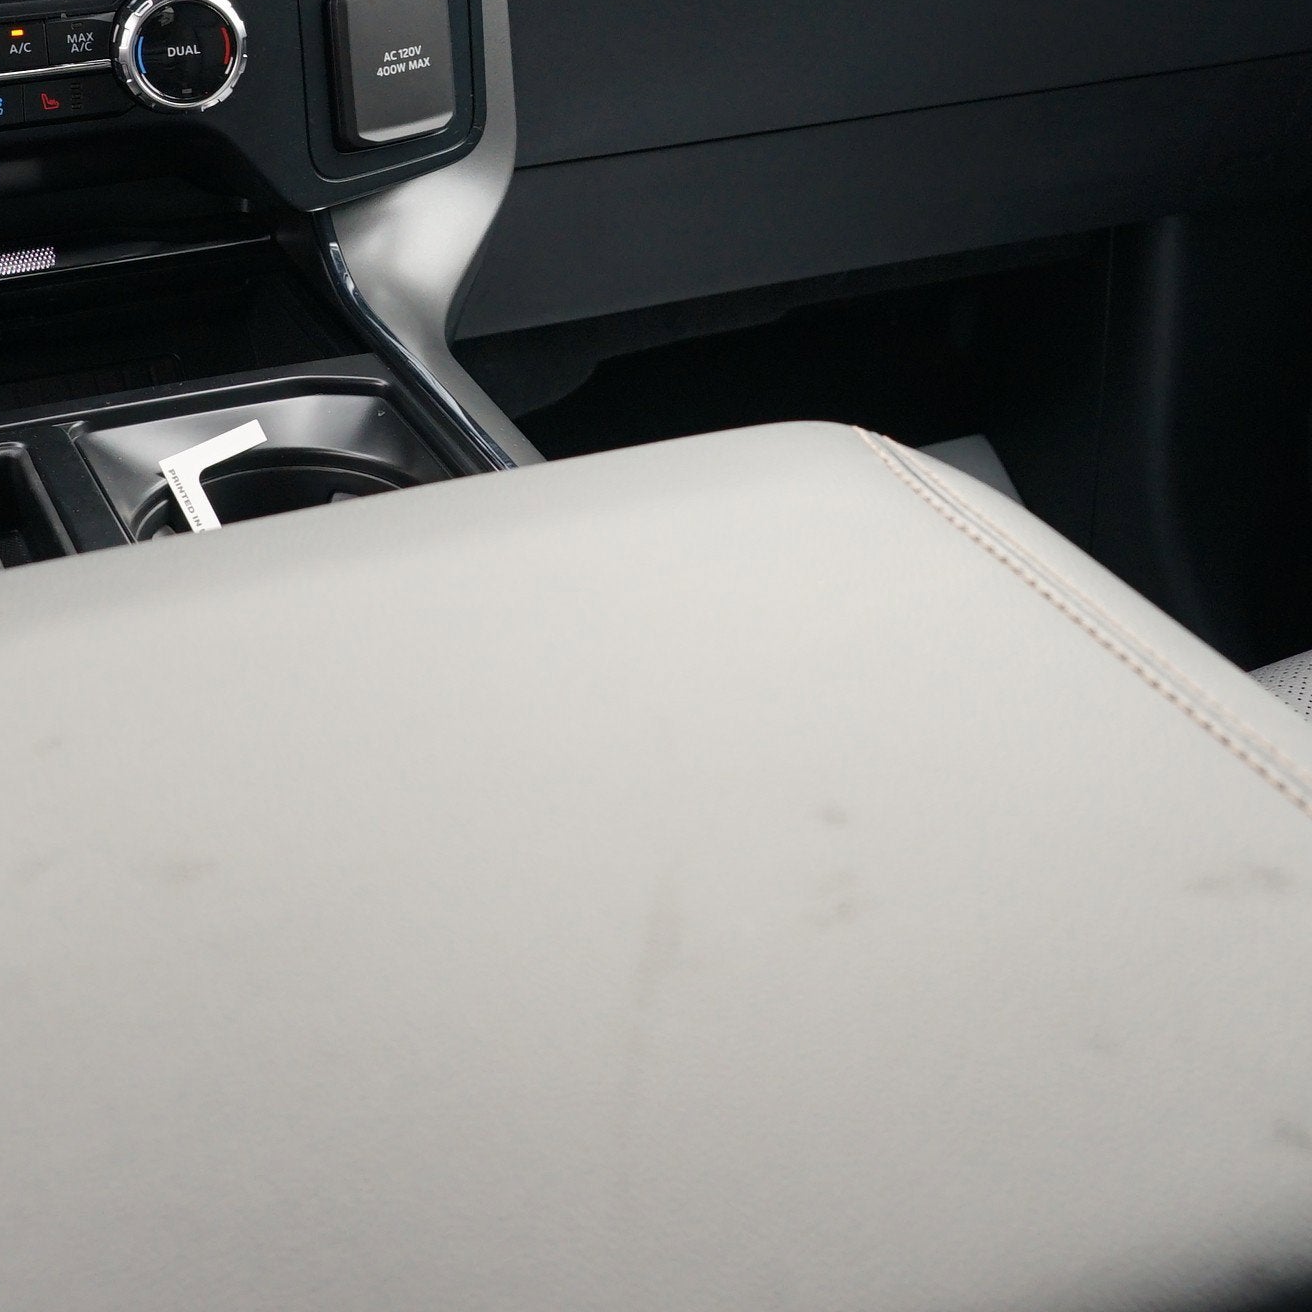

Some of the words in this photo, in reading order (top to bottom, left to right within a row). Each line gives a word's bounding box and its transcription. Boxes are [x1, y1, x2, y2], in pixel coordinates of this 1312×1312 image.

[66, 31, 95, 44] MAX
[8, 41, 32, 55] A/C
[69, 41, 93, 54] A/C
[166, 43, 201, 59] DUAL
[383, 49, 398, 63] AC
[398, 44, 423, 60] 120V
[376, 61, 407, 77] 400W
[407, 55, 431, 72] MAX
[167, 468, 196, 515] PRINTED
[192, 516, 203, 527] IN
